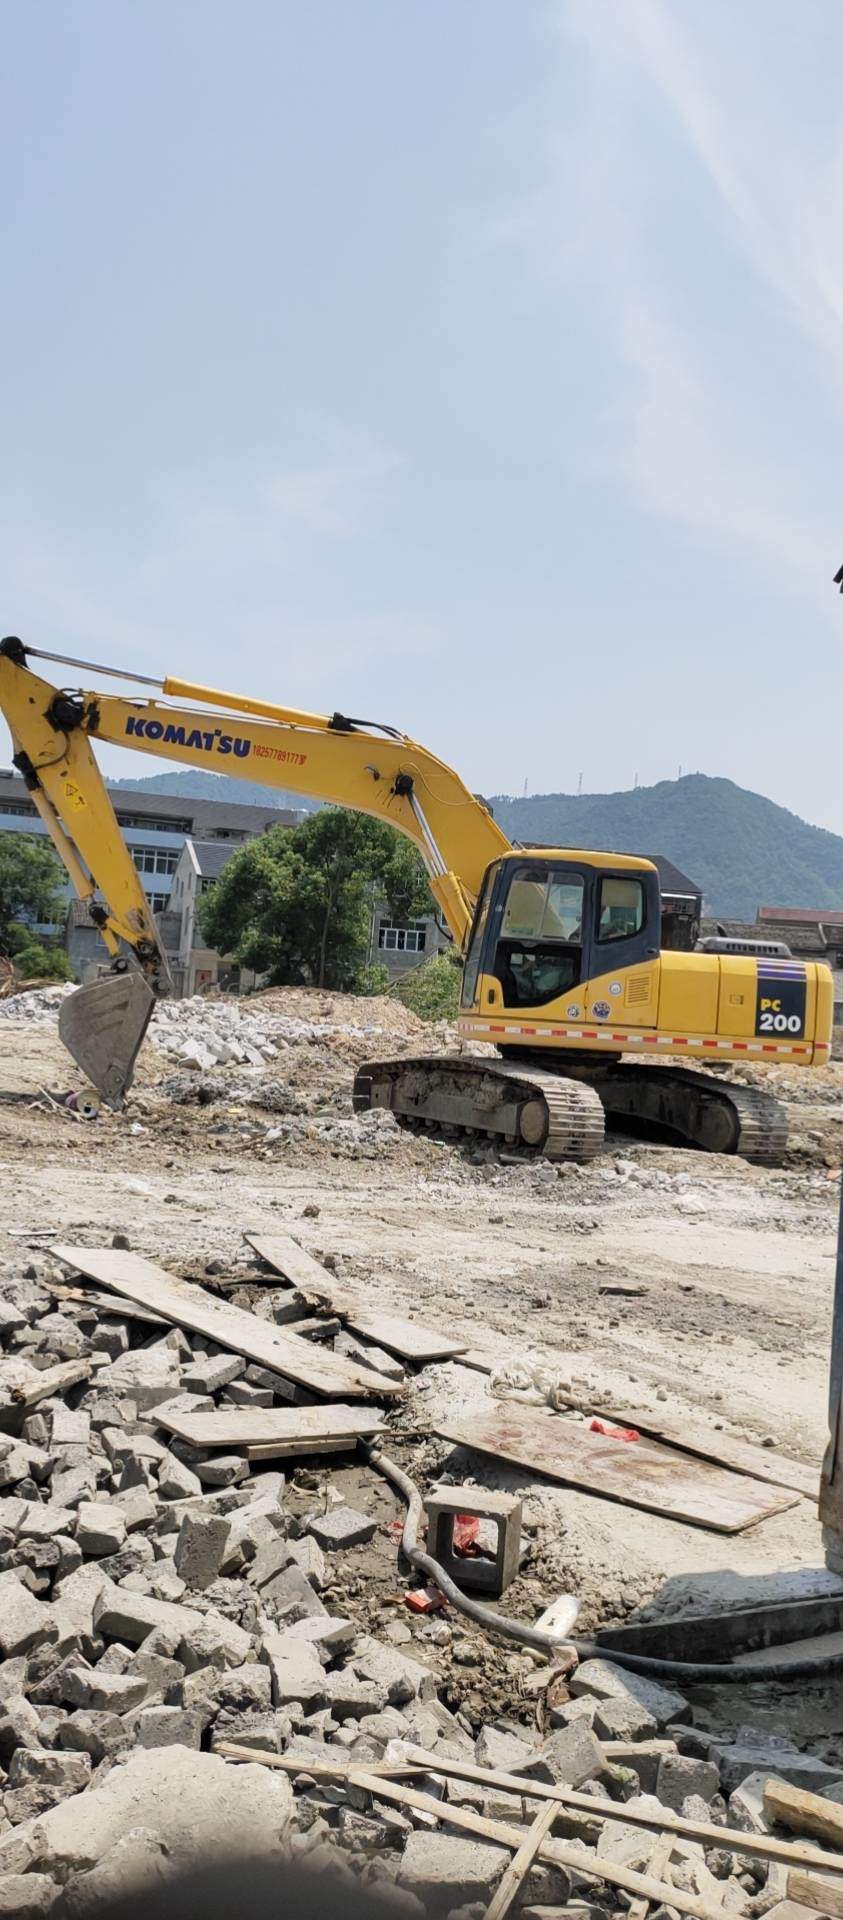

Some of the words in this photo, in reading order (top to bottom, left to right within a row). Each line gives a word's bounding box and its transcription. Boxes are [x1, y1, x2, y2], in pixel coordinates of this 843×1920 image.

[125, 716, 251, 758] KOMATSU
[760, 998, 781, 1012] PC
[759, 1013, 802, 1032] 200
